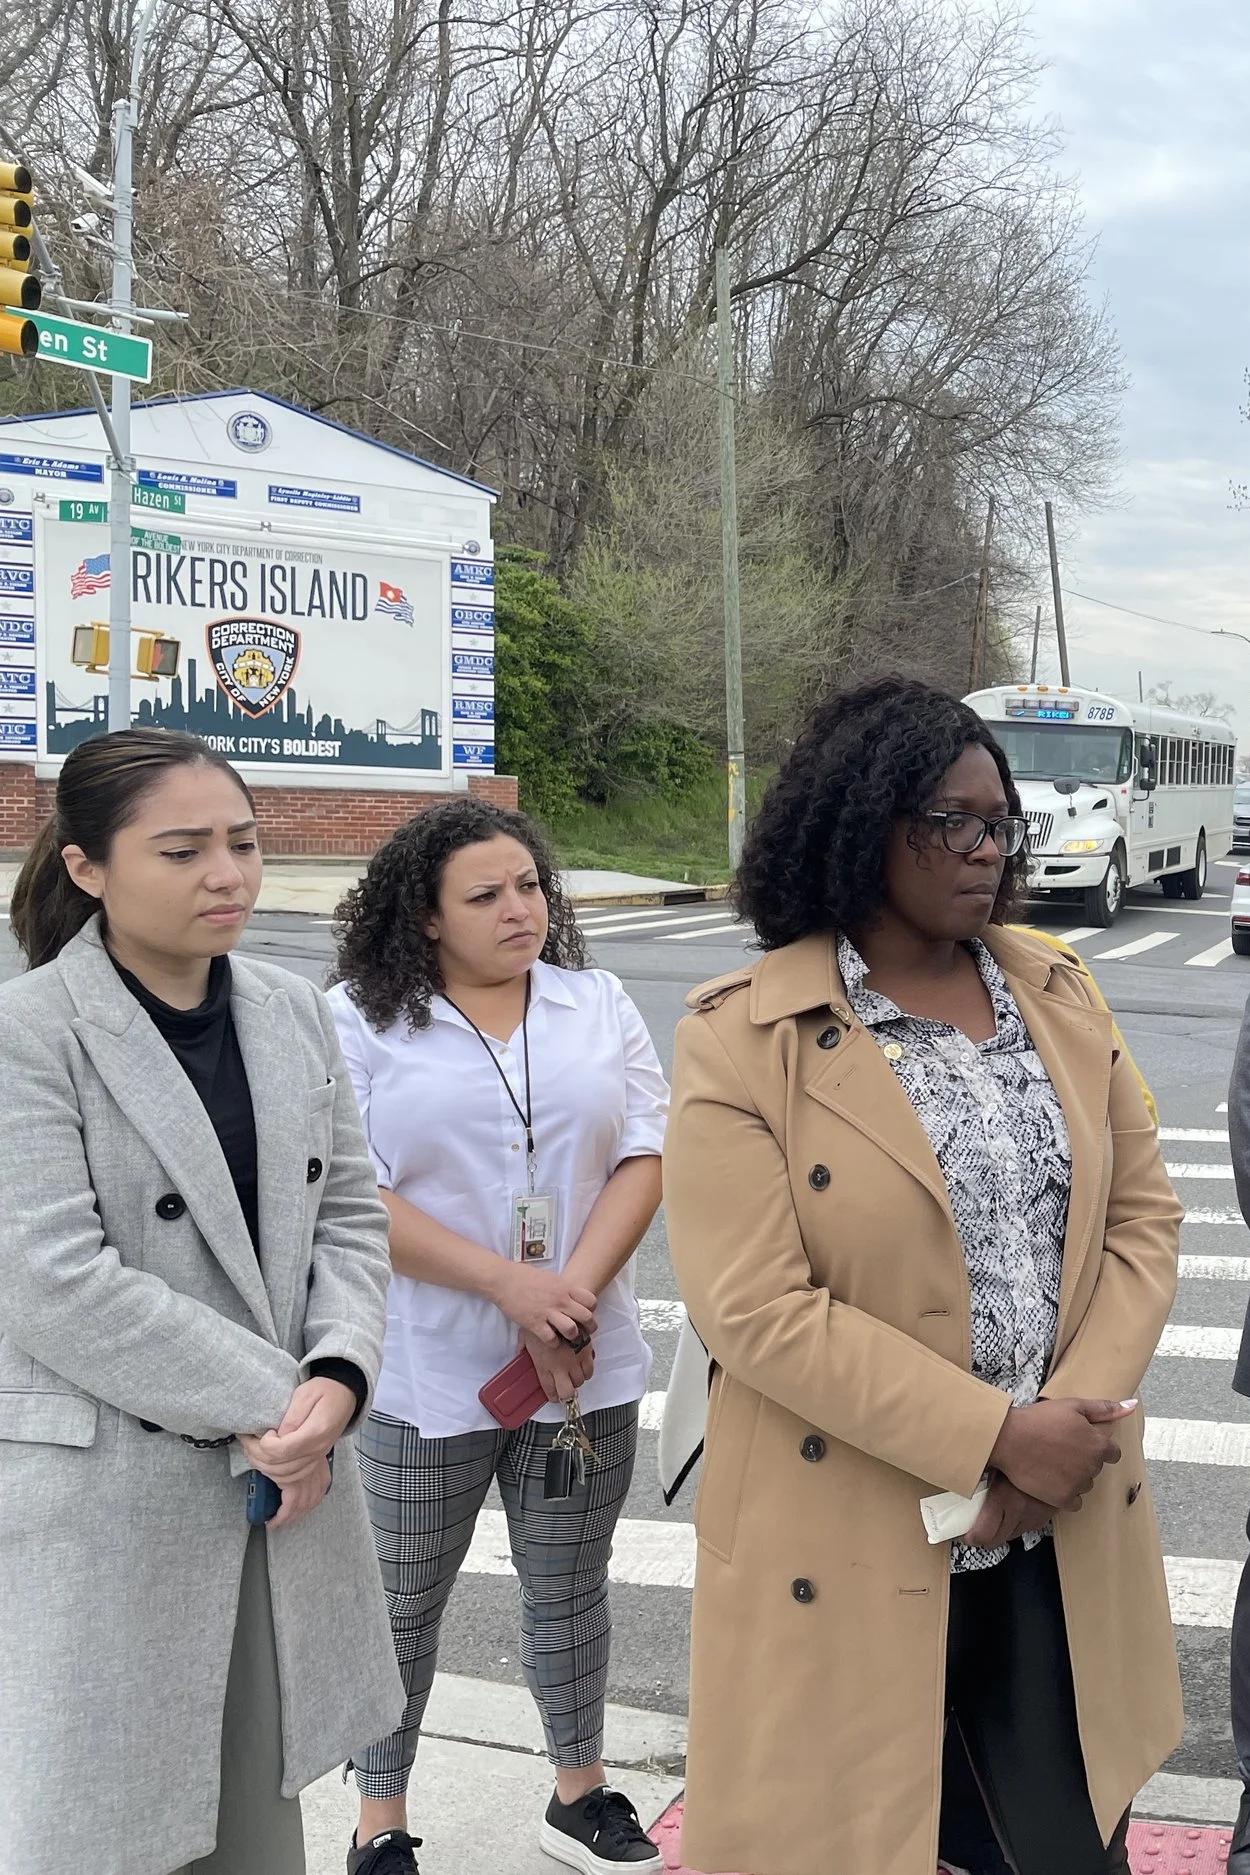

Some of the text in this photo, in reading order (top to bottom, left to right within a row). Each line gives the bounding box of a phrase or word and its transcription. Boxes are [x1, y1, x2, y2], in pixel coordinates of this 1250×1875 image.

[39, 330, 108, 362] en St
[22, 457, 40, 466] Eric
[51, 461, 79, 470] Adams
[35, 468, 67, 478] MAYOR
[157, 473, 179, 482] Louis
[190, 477, 217, 486] Molina
[158, 482, 217, 495] COMMISSIONER
[134, 487, 182, 509] Hazen St
[70, 503, 84, 519] 19
[197, 541, 215, 553] YORK
[216, 543, 231, 555] CITY
[232, 545, 274, 560] DEPARTMENT
[285, 550, 323, 564] CORRECTION
[454, 564, 492, 576] AMKC
[132, 551, 368, 621] RIKERS ISLAND
[454, 610, 492, 621] OBCC
[212, 622, 294, 643] CORRECTION
[212, 634, 294, 654] DEPARTMENT
[454, 655, 493, 666] GMDC
[216, 662, 247, 702] CITY OF
[258, 657, 294, 708] NEW YORK
[455, 700, 493, 711] RMSC
[1088, 707, 1114, 720] 878B
[239, 737, 280, 754] CITY'S
[283, 739, 342, 758] BOLDEST
[463, 745, 486, 755] WF
